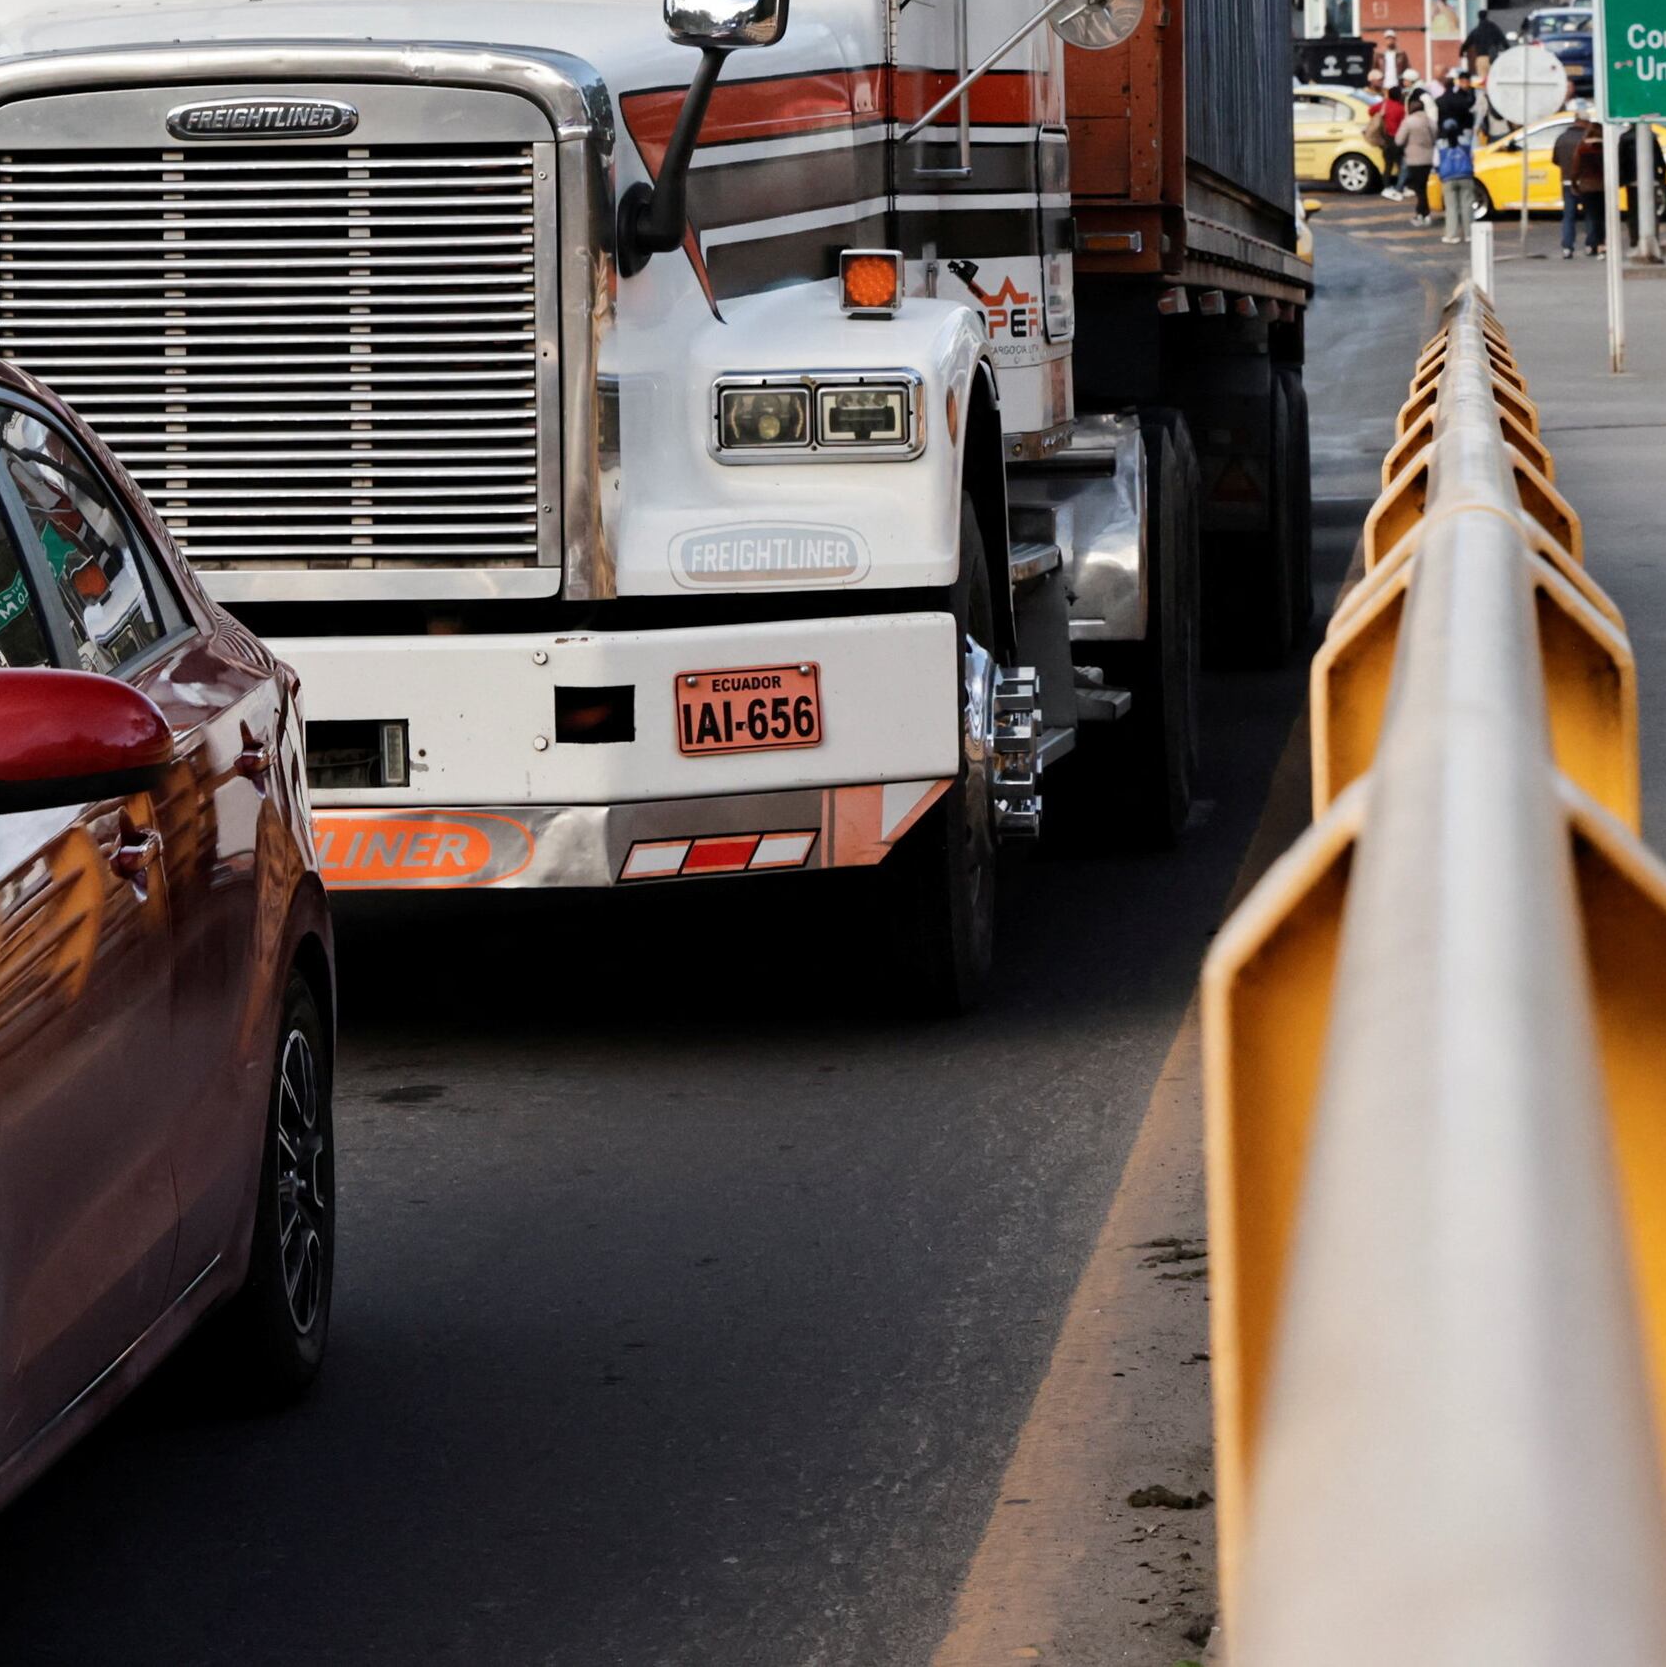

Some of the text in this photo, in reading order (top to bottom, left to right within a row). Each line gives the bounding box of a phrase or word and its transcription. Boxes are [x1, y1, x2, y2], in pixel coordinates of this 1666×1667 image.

[186, 107, 335, 130] FREIGHTLINER
[691, 538, 850, 572] FREIGHTLINER
[711, 676, 781, 692] ECUADOR
[682, 695, 814, 744] IAI-656
